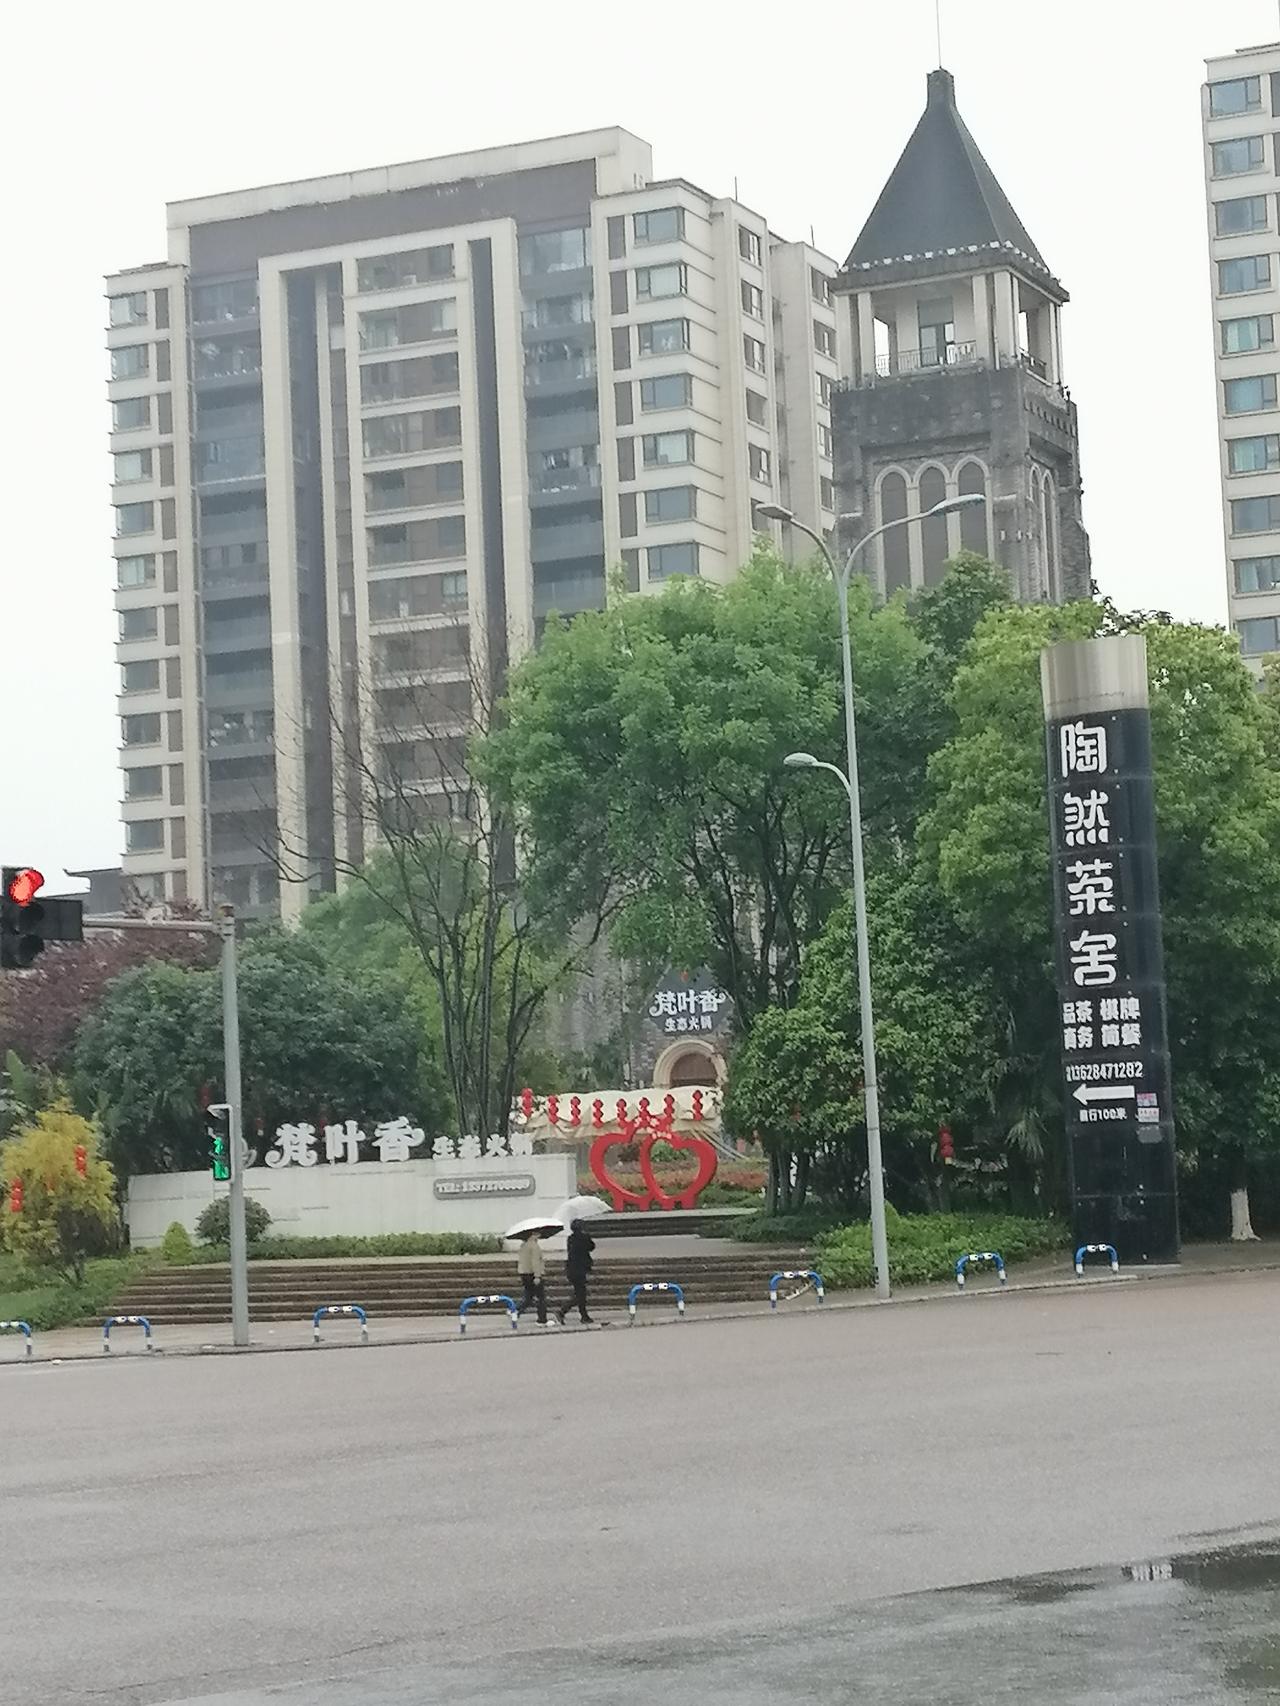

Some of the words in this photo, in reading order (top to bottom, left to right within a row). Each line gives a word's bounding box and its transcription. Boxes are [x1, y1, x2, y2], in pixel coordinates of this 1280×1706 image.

[1060, 720, 1118, 987] 陶然茶舍
[1063, 1000, 1093, 1024] 品茶
[1100, 997, 1141, 1021] 棋牌
[1063, 1025, 1093, 1050] 商务
[1101, 1023, 1141, 1047] 简餐
